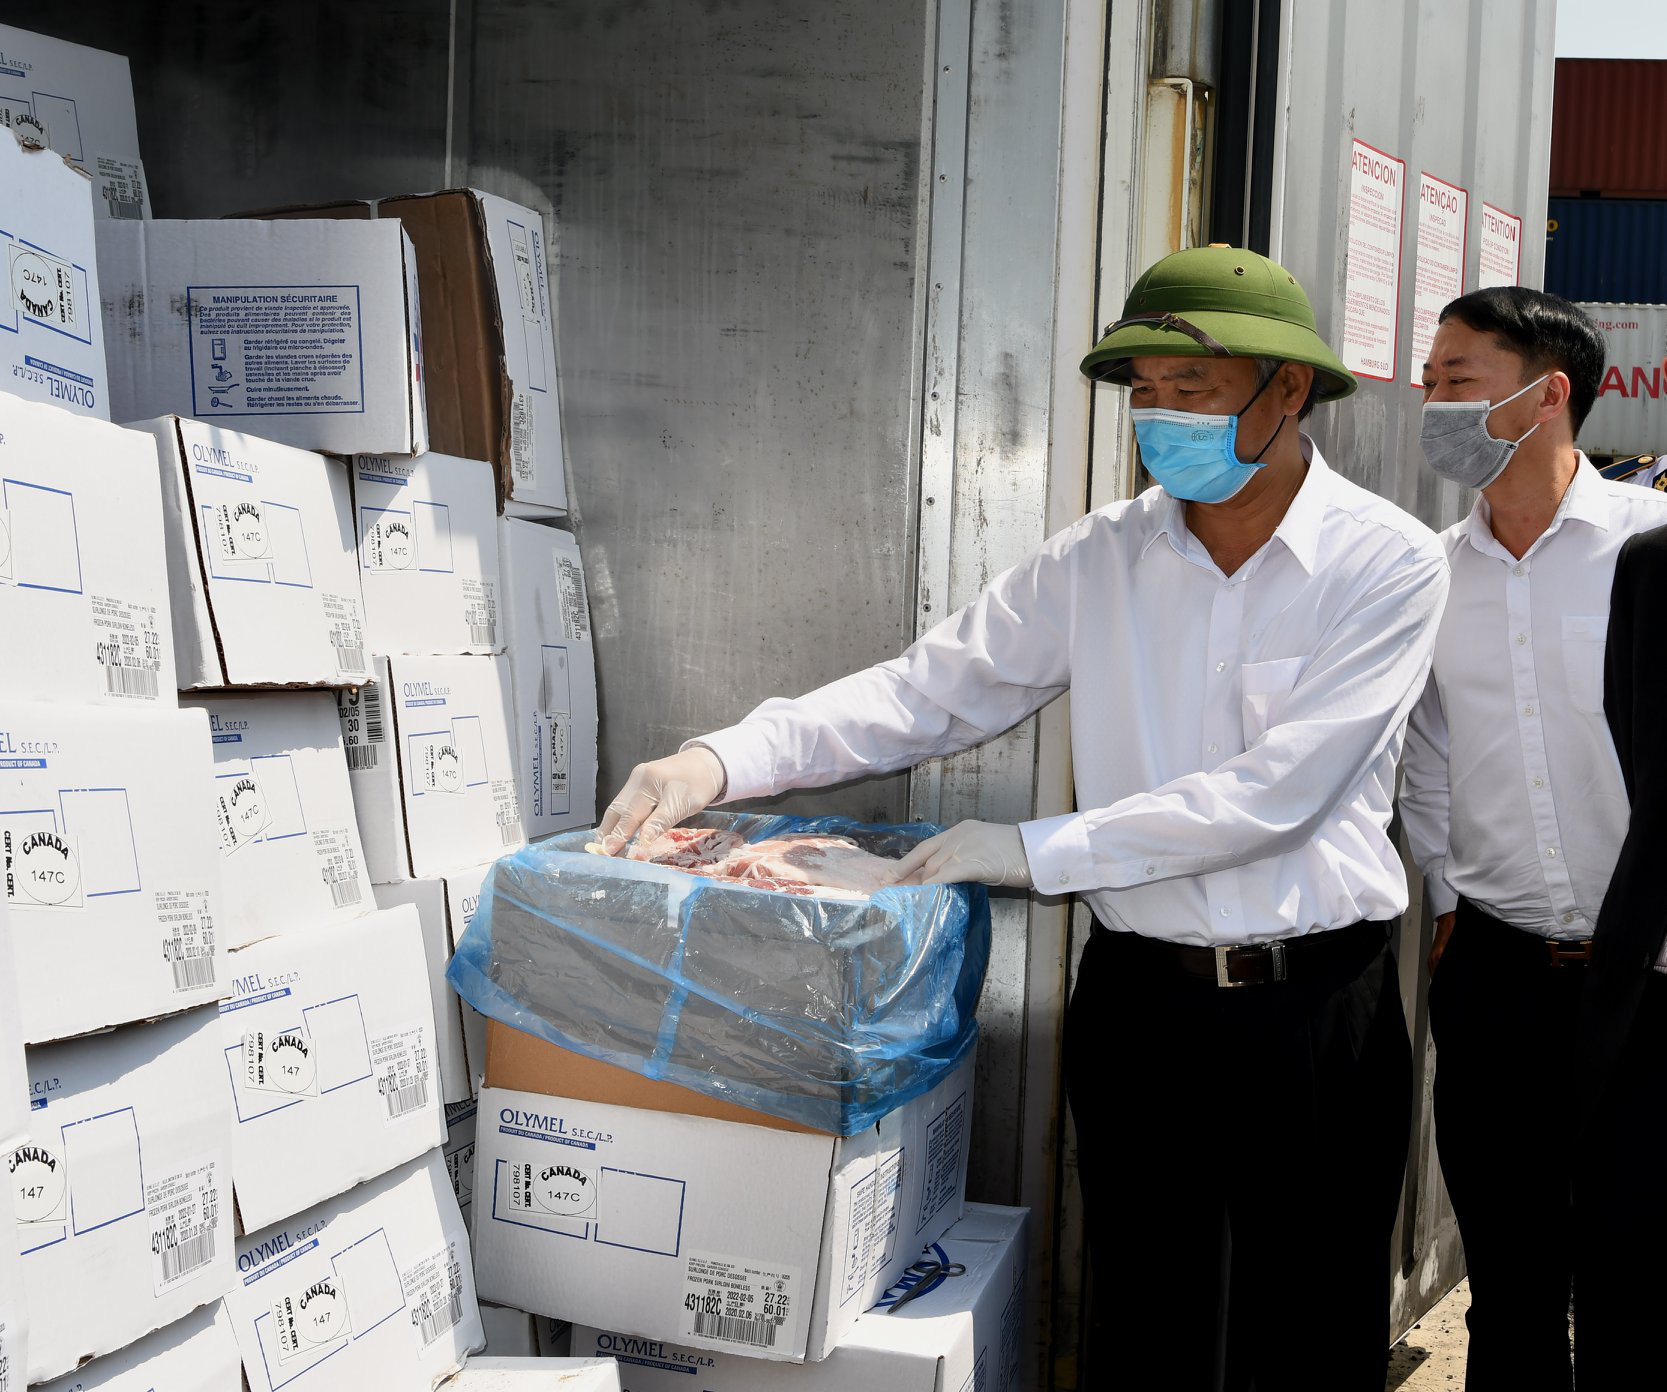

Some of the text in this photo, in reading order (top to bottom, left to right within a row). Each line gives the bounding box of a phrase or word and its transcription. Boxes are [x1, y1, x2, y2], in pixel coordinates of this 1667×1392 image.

[16, 114, 44, 135] CANADA
[1352, 150, 1396, 187] ATENCION
[1420, 183, 1457, 214] ATENÇÃO
[23, 269, 47, 286] 147C
[20, 289, 54, 317] CANADA
[64, 270, 74, 324] 798107
[280, 294, 338, 303] SÉCURITAIRE
[46, 377, 95, 408] OLYMEL
[1595, 366, 1667, 399] AN
[193, 444, 235, 468] OLYMEL
[358, 455, 393, 474] OLYMEL
[234, 503, 260, 523] CANADA
[242, 532, 261, 542] 147C
[385, 523, 408, 540] CANADA
[390, 547, 408, 556] 147C
[96, 642, 122, 666] 431182C
[404, 682, 433, 697] OLYMEL
[348, 719, 359, 732] 30
[438, 746, 458, 763] CANADA
[442, 770, 457, 779] 147C
[231, 779, 256, 806] CANADA
[241, 804, 260, 824] 147C
[22, 832, 69, 860] CANADA
[31, 870, 65, 884] 147C
[272, 1036, 308, 1059] CANADA
[282, 1065, 300, 1076] 147
[500, 1108, 567, 1134] OLYMEL
[572, 1128, 613, 1143] S.E.C./L.P.
[501, 1126, 518, 1134] PRODUIT
[544, 1135, 564, 1143] PRODUCT
[541, 1166, 587, 1186] CANADA
[20, 1186, 44, 1200] 147
[548, 1191, 580, 1202] 147C
[152, 1189, 217, 1254] 431182C 27.22
[238, 1231, 294, 1272] OLYMEL
[300, 1242, 314, 1255] CANADA
[702, 1278, 714, 1286] PORK
[730, 1283, 750, 1291] BONELESS
[715, 1270, 727, 1279] PORC
[284, 1297, 293, 1315] CERT
[300, 1284, 336, 1309] CANADA
[684, 1290, 788, 1316] 431182C 2022-02-05 27.22
[313, 1312, 331, 1326] 147
[725, 1303, 786, 1320] 2020.02.06 60.01
[275, 1302, 290, 1351] 798107
[597, 1334, 715, 1368] OLYMEL S.E.C./L.P.
